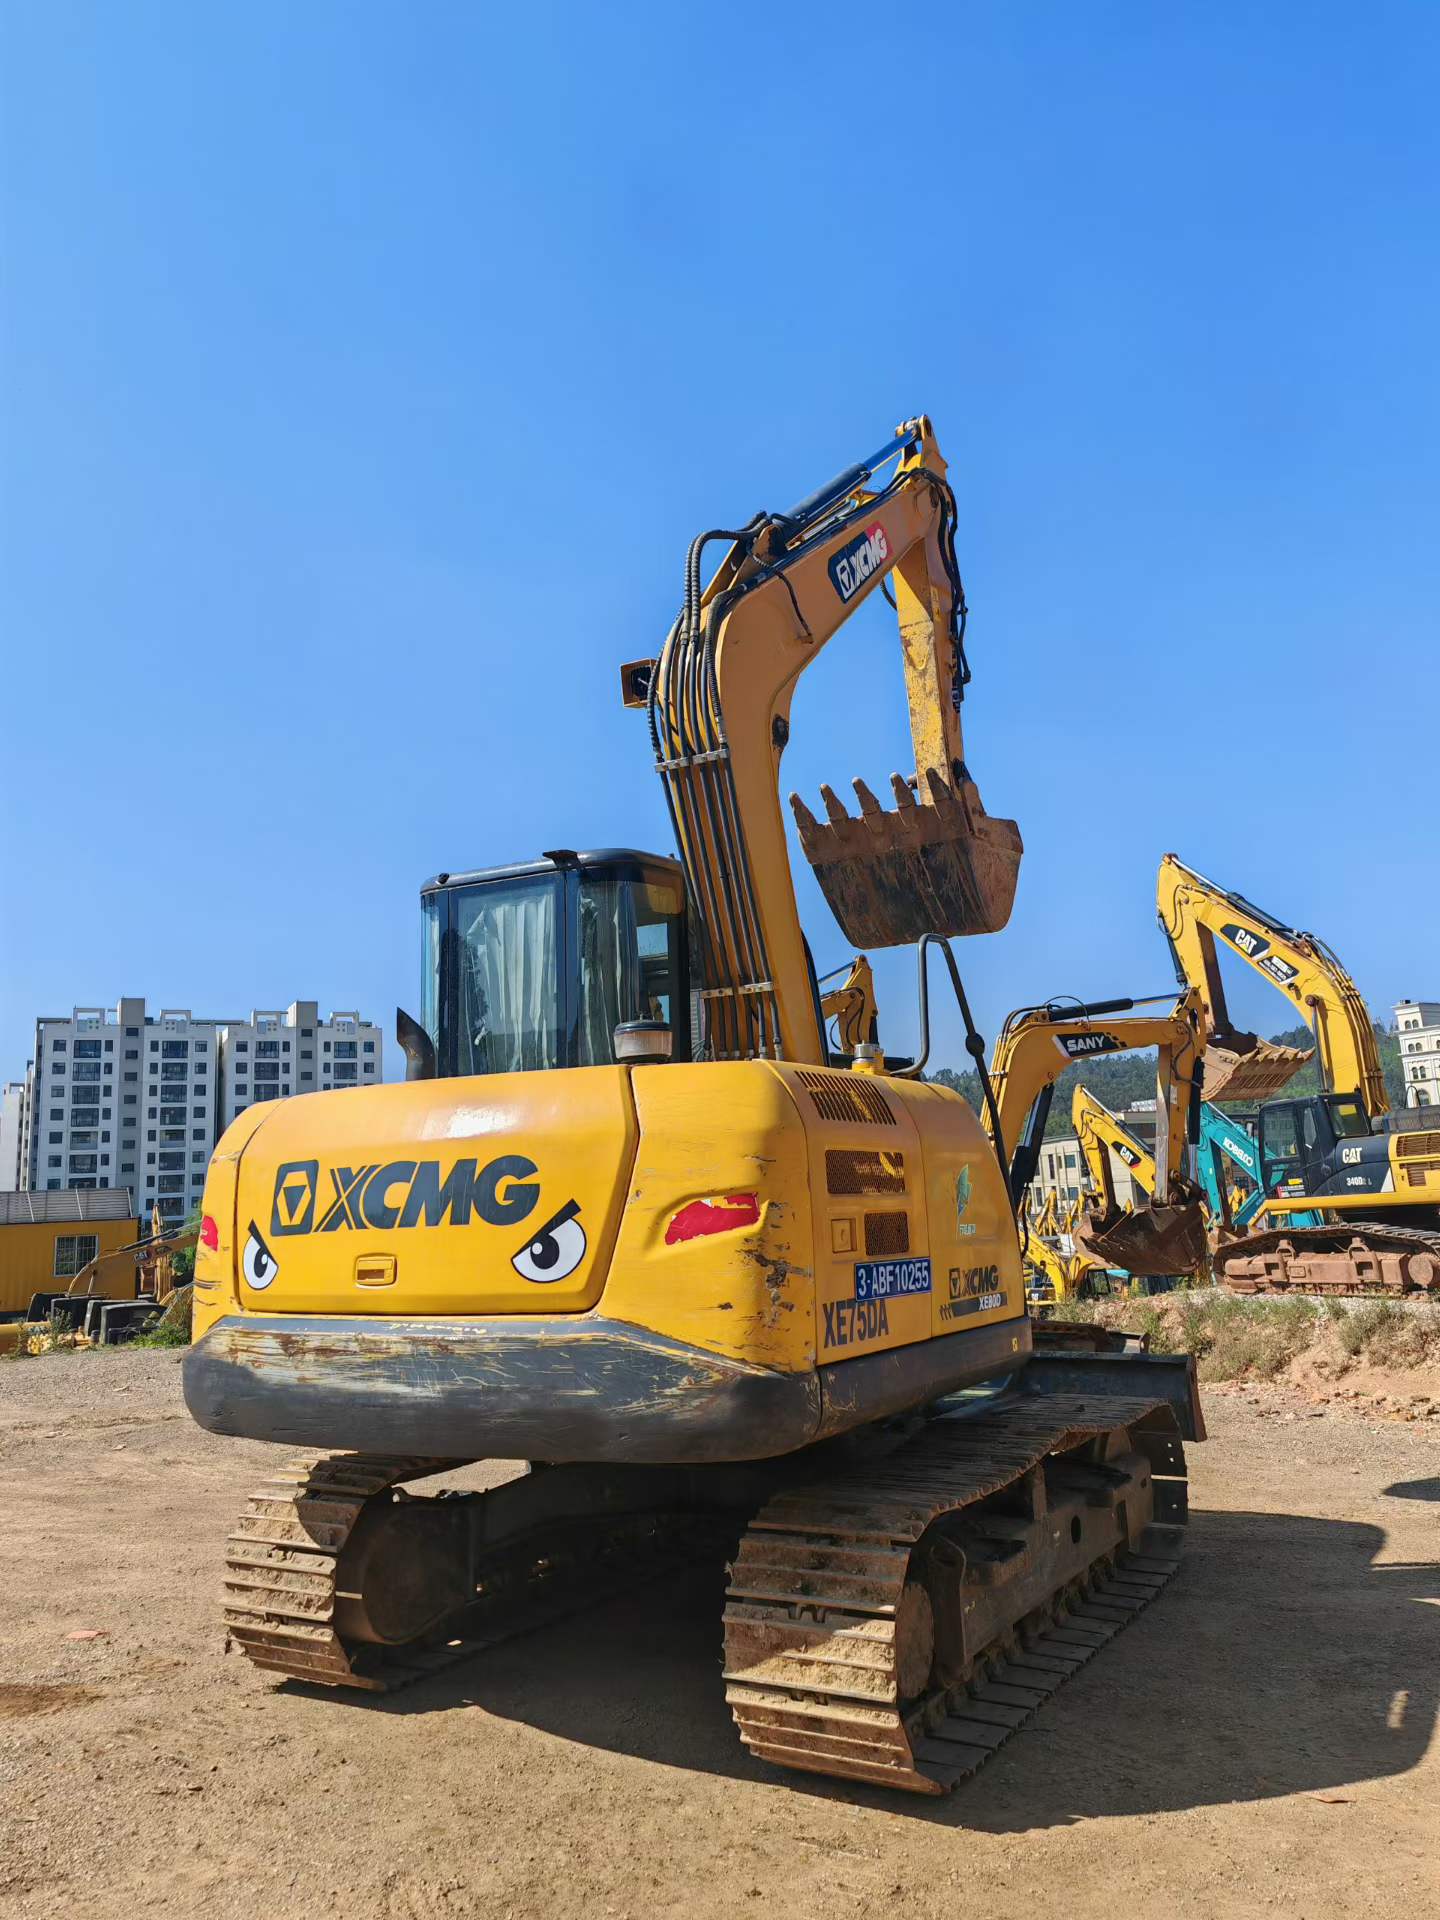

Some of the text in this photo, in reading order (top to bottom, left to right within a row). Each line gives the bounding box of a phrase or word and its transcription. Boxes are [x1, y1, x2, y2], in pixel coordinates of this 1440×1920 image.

[849, 528, 888, 589] XCMG
[1235, 929, 1258, 954] CAT
[1067, 1036, 1104, 1051] SANY
[1120, 1147, 1134, 1163] CAT
[1223, 1137, 1253, 1167] KOBELCO
[1342, 1147, 1362, 1164] CAT
[313, 1154, 541, 1232] XCMG
[858, 1261, 930, 1298] 3-ABF10255
[961, 1265, 998, 1296] XCMG
[822, 1298, 889, 1349] XE75DA
